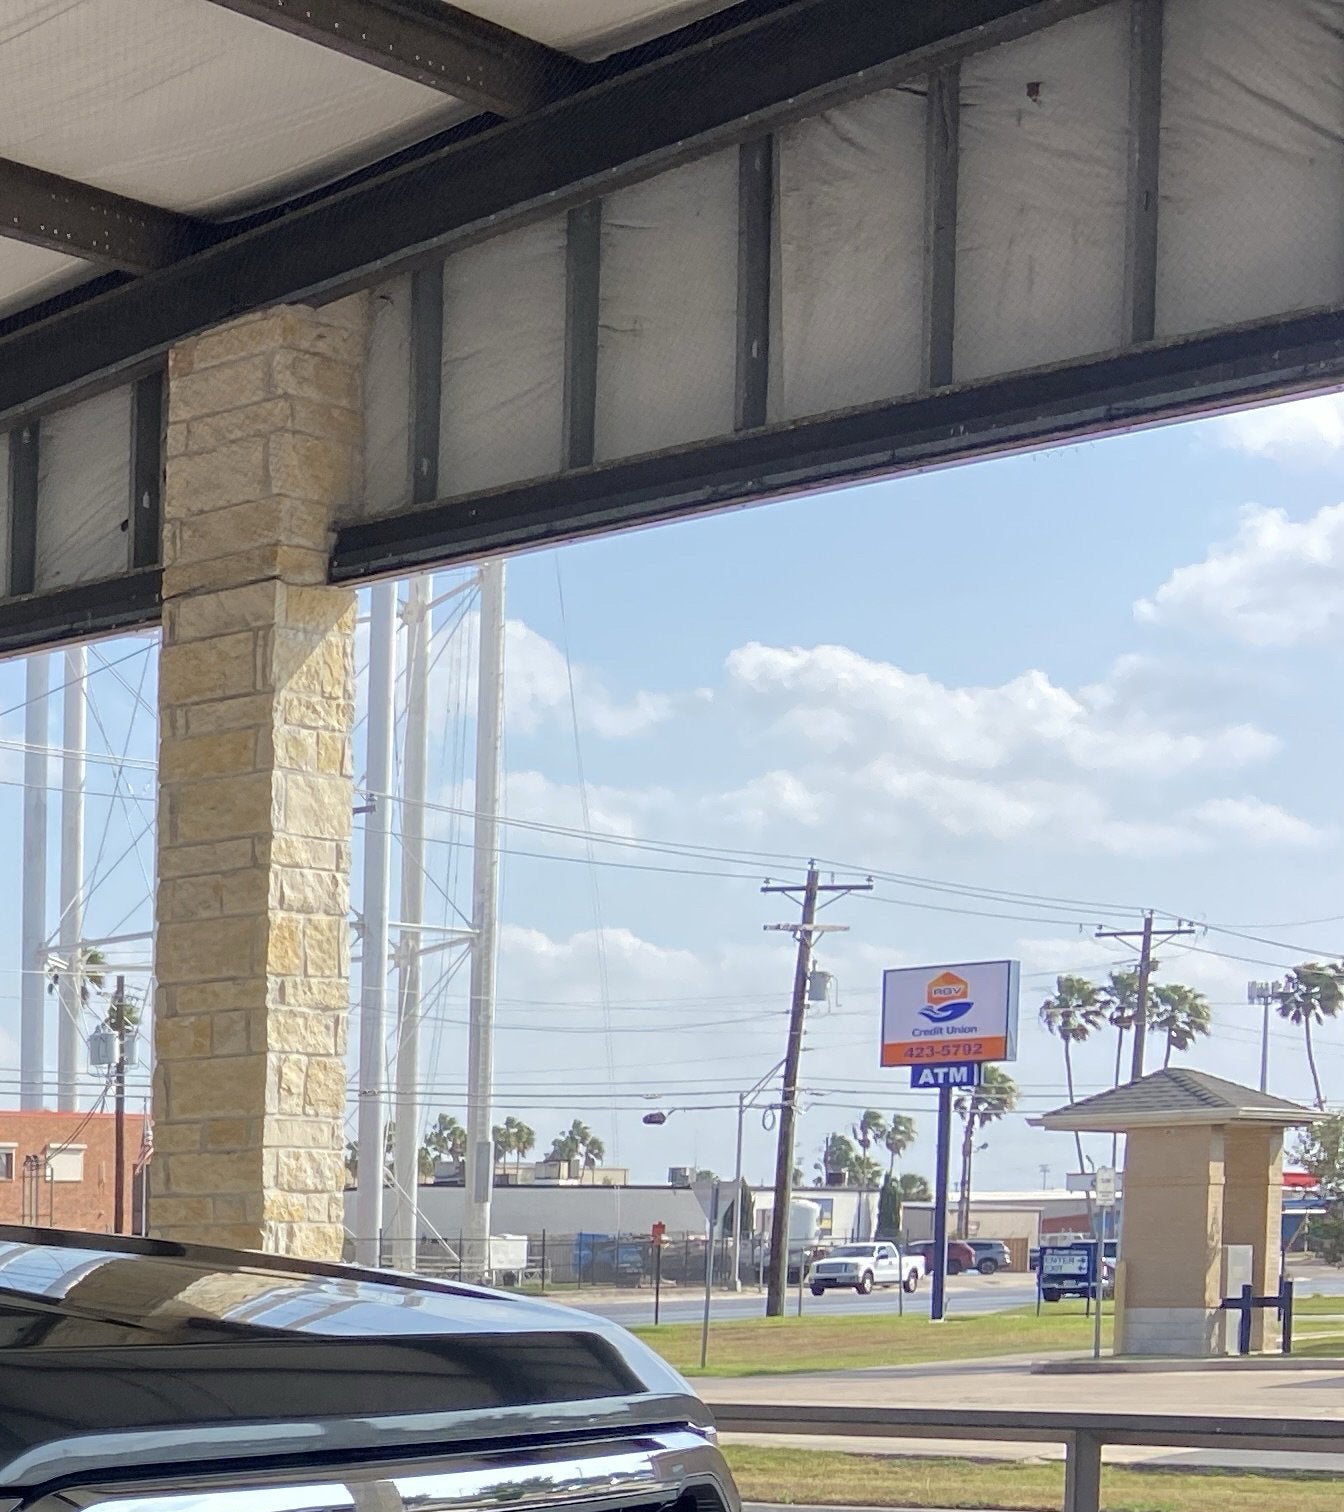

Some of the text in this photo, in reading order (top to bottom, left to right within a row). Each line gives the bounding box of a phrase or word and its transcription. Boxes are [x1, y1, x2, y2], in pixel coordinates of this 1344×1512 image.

[933, 987, 962, 996] RGV
[912, 1025, 978, 1037] Credit Union
[918, 1066, 968, 1085] ATM
